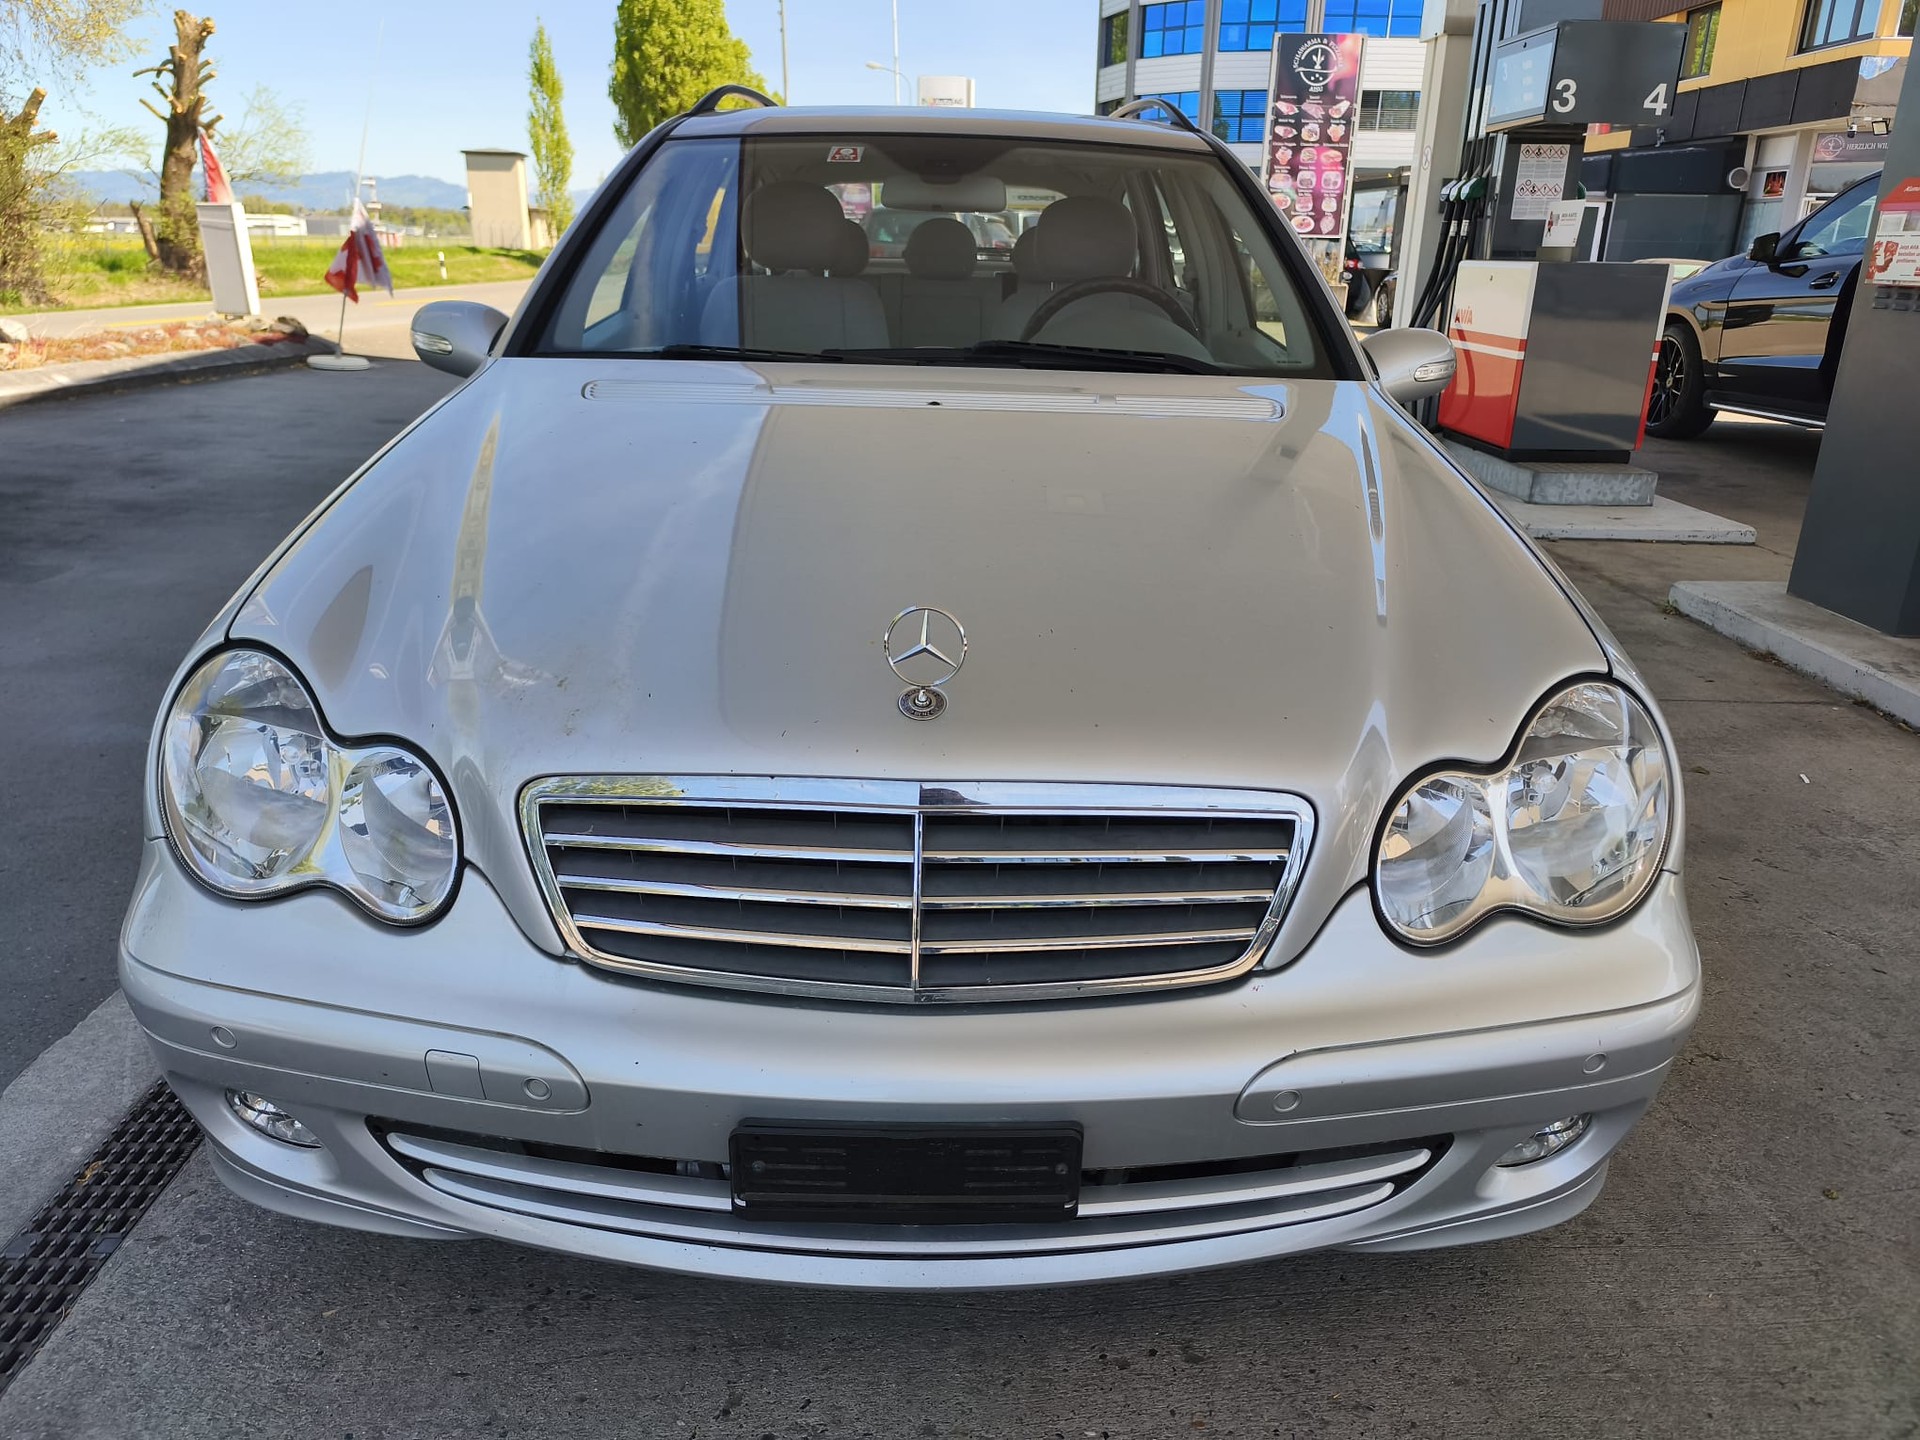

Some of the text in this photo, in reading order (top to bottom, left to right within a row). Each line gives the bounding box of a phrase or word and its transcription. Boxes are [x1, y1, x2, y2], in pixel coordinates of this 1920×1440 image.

[1552, 78, 1577, 113] 3
[1643, 83, 1668, 116] 4
[1454, 306, 1473, 325] AVIA
